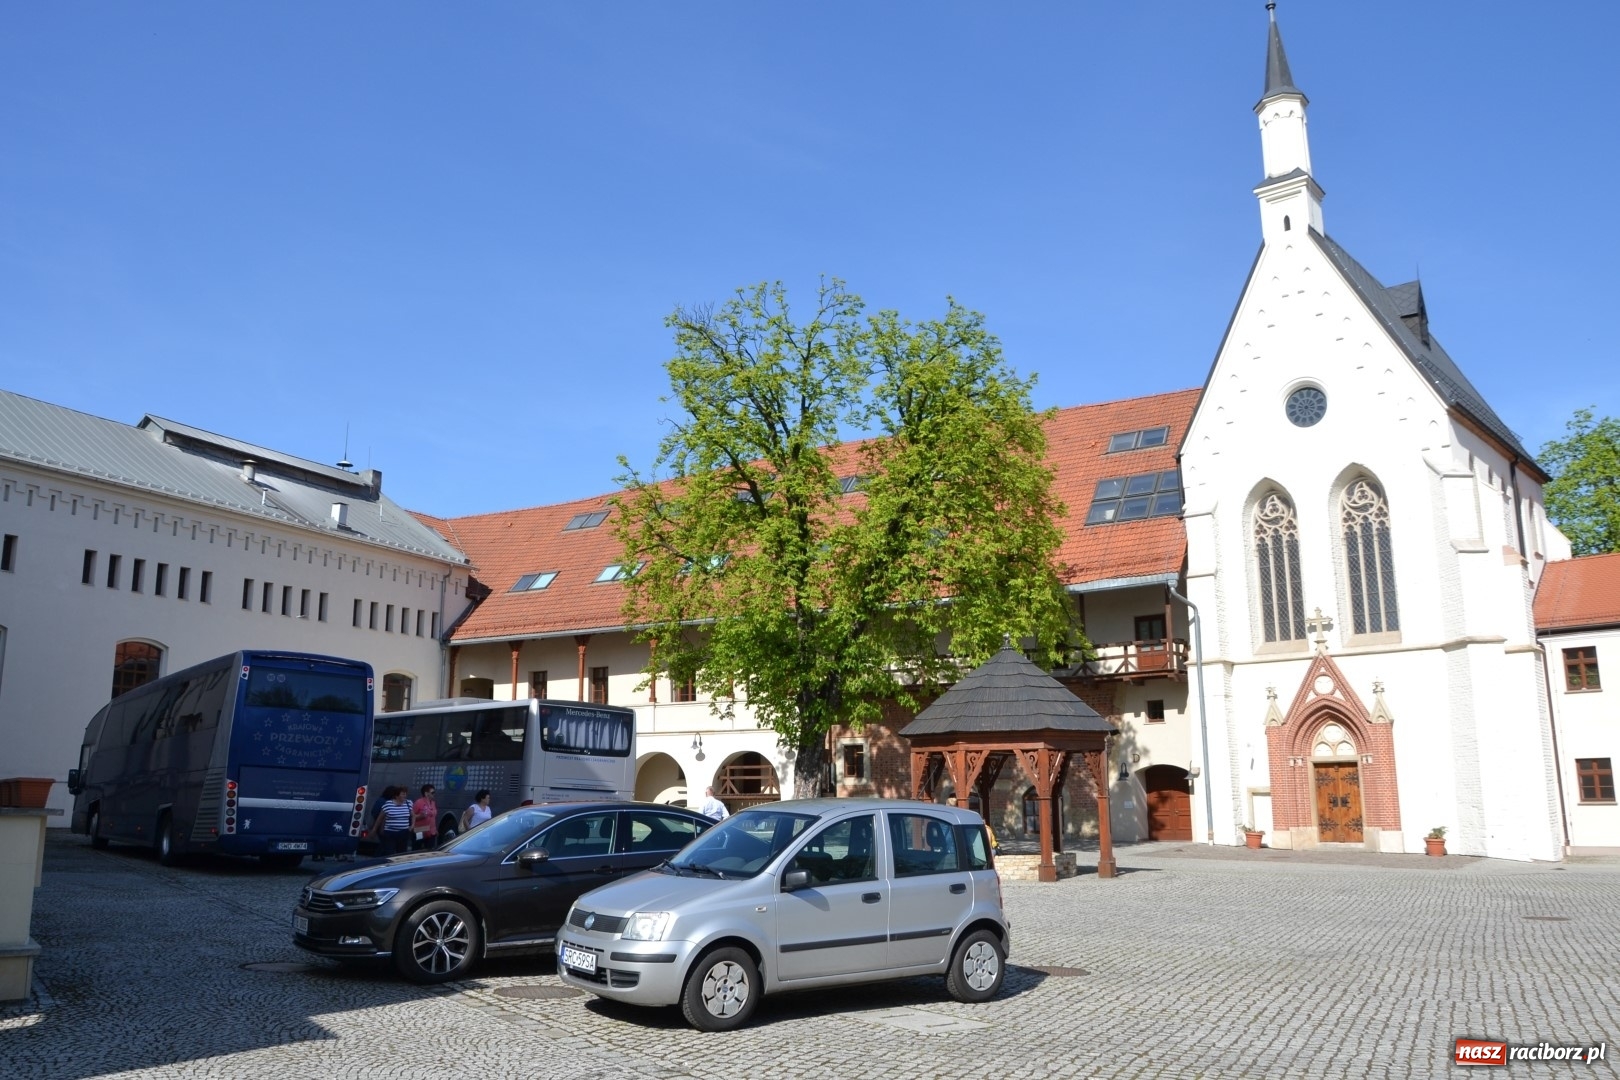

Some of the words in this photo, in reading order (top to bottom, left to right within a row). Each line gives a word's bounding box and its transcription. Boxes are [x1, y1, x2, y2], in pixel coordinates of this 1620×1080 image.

[565, 708, 611, 719] Mercedes-Benz
[270, 732, 338, 745] PRZEWOZY
[1132, 753, 1141, 763] D
